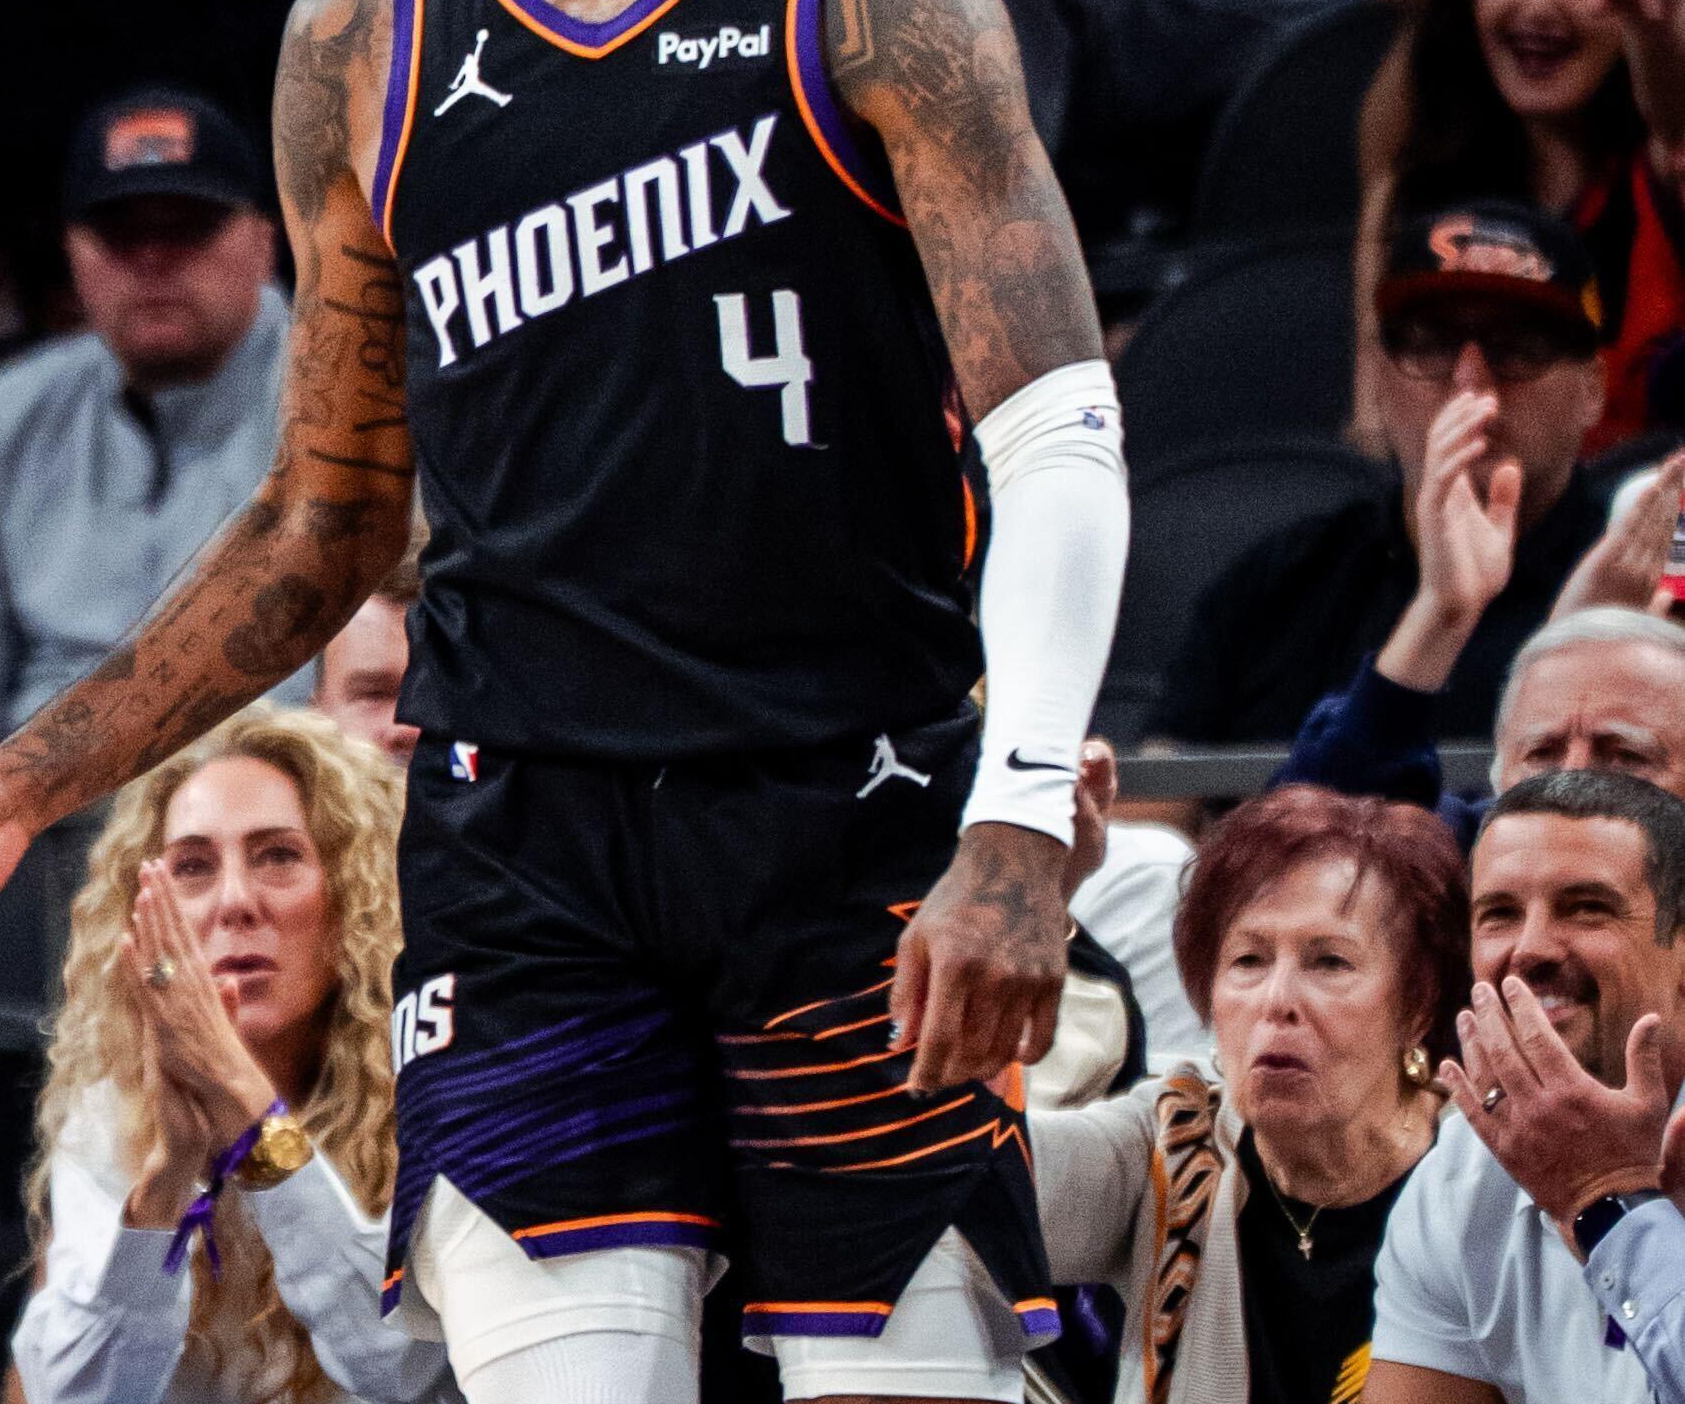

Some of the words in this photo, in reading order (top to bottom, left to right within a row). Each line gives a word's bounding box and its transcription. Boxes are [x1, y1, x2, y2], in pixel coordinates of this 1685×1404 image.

[658, 25, 771, 70] PayPal
[414, 112, 794, 369] PHOENIX
[712, 289, 816, 447] 4
